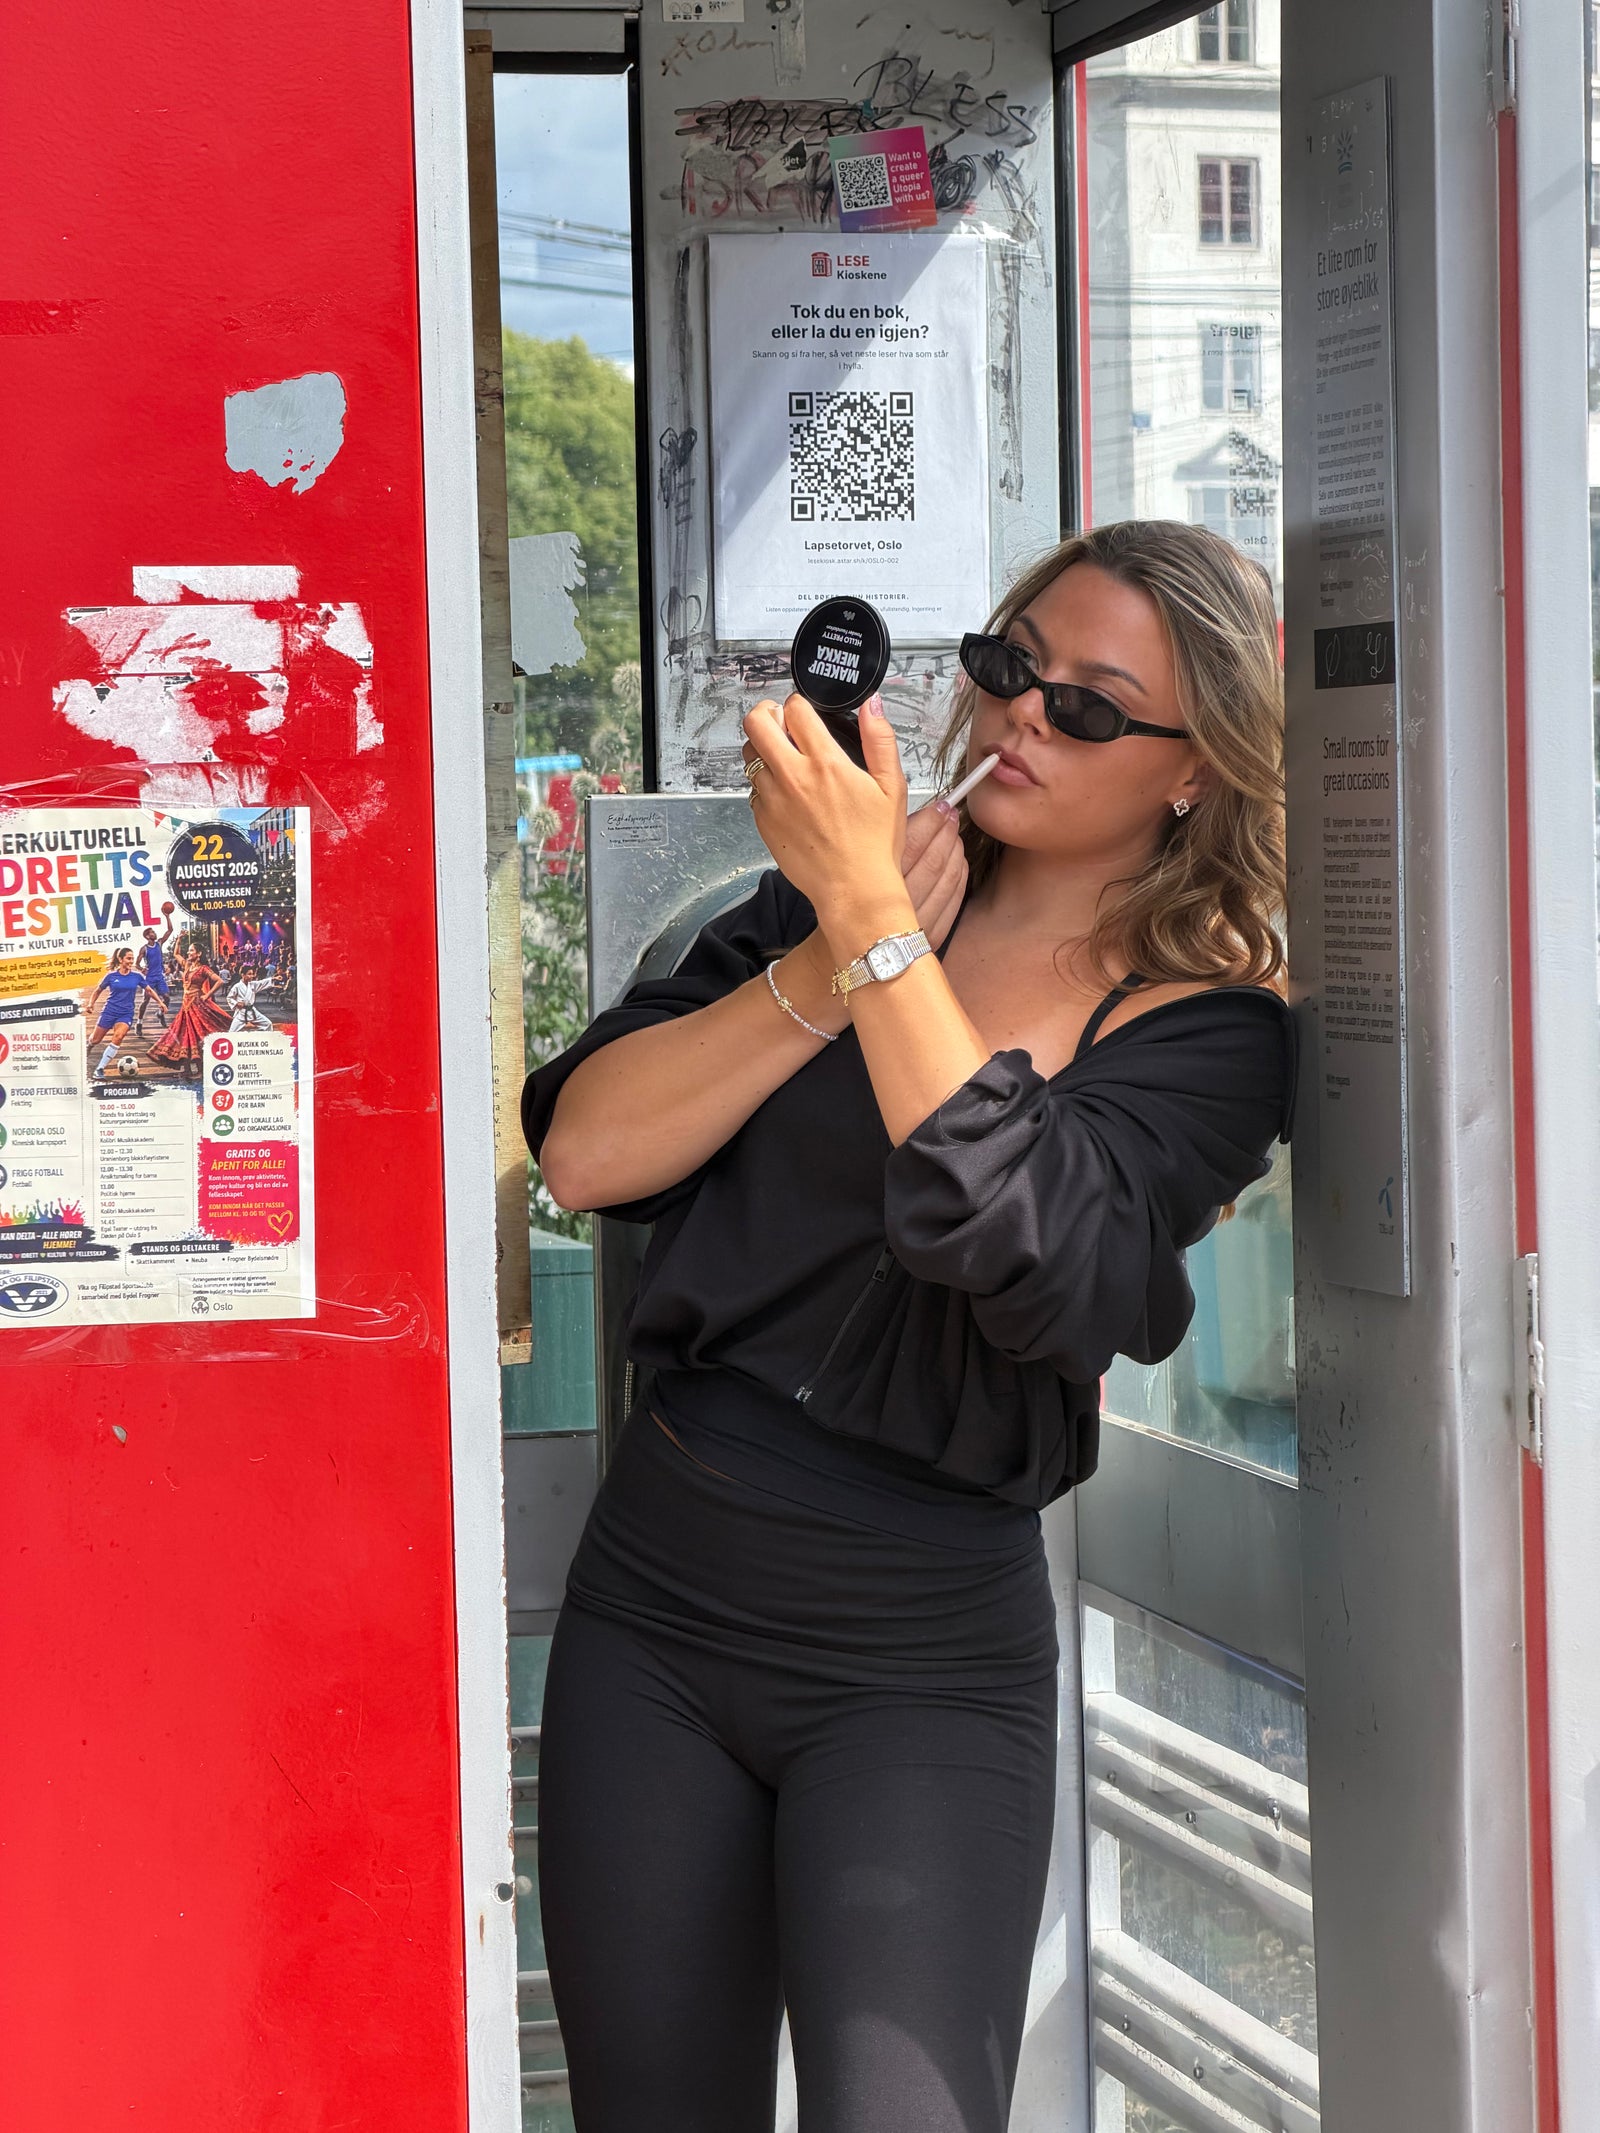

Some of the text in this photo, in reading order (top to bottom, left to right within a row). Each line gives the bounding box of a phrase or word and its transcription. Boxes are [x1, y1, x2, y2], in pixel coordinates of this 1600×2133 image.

[888, 151, 921, 162] Want to
[891, 162, 918, 172] create
[900, 172, 924, 183] queer
[893, 183, 921, 193] Utopia
[895, 191, 930, 203] with us?
[837, 255, 870, 266] LESE
[1317, 239, 1377, 276] Et lite rom for
[837, 270, 887, 280] Kioskene
[1317, 272, 1379, 311] store øyeblikk
[790, 305, 910, 322] Tok du en bok,
[772, 325, 929, 342] eller la du en igjen?
[752, 350, 777, 358] Skann
[779, 352, 789, 360] og
[791, 350, 798, 358] si
[799, 350, 810, 358] fra
[812, 350, 826, 360] her,
[829, 350, 838, 358] så
[878, 350, 897, 358] leser
[899, 350, 913, 358] hva
[933, 350, 949, 358] står
[843, 363, 864, 371] hylla.
[804, 540, 902, 552] Lapsetorvet, Oslo
[821, 631, 862, 647] HELLO PRETTY
[816, 644, 860, 668] MEKKA
[808, 659, 860, 684] MAKEUP
[1323, 734, 1389, 759] Small rooms for
[1323, 767, 1390, 796] great occasions
[0, 827, 146, 855] ERKULTURELL
[192, 834, 232, 861] 22.
[175, 861, 258, 880] AUGUST 2026
[182, 886, 252, 900] VIKA TERRASSEN
[191, 902, 203, 911] KL.
[2, 890, 161, 938] ESTIVAL
[28, 938, 65, 950] KULTUR
[77, 932, 131, 945] FELLESSKAP
[0, 1005, 74, 1019] DISSE AKTIVITETENE!
[12, 1033, 29, 1041] VIKA
[30, 1033, 40, 1041] OG
[12, 1043, 61, 1052] SPORTSKLUBB
[103, 1088, 139, 1096] PROGRAM
[47, 1127, 65, 1135] OSLO
[226, 1148, 271, 1159] GRATIS OG
[211, 1159, 286, 1171] ÅPENT FOR ALLE!
[12, 1168, 64, 1177] FRIGG FOTBALL
[0, 1231, 82, 1240] KAN DELTA ALLE HØRER
[43, 1240, 76, 1249] HJEMME!
[142, 1245, 169, 1253] STANDS
[182, 1244, 220, 1252] DELTAKERE
[213, 1302, 233, 1311] Oslo
